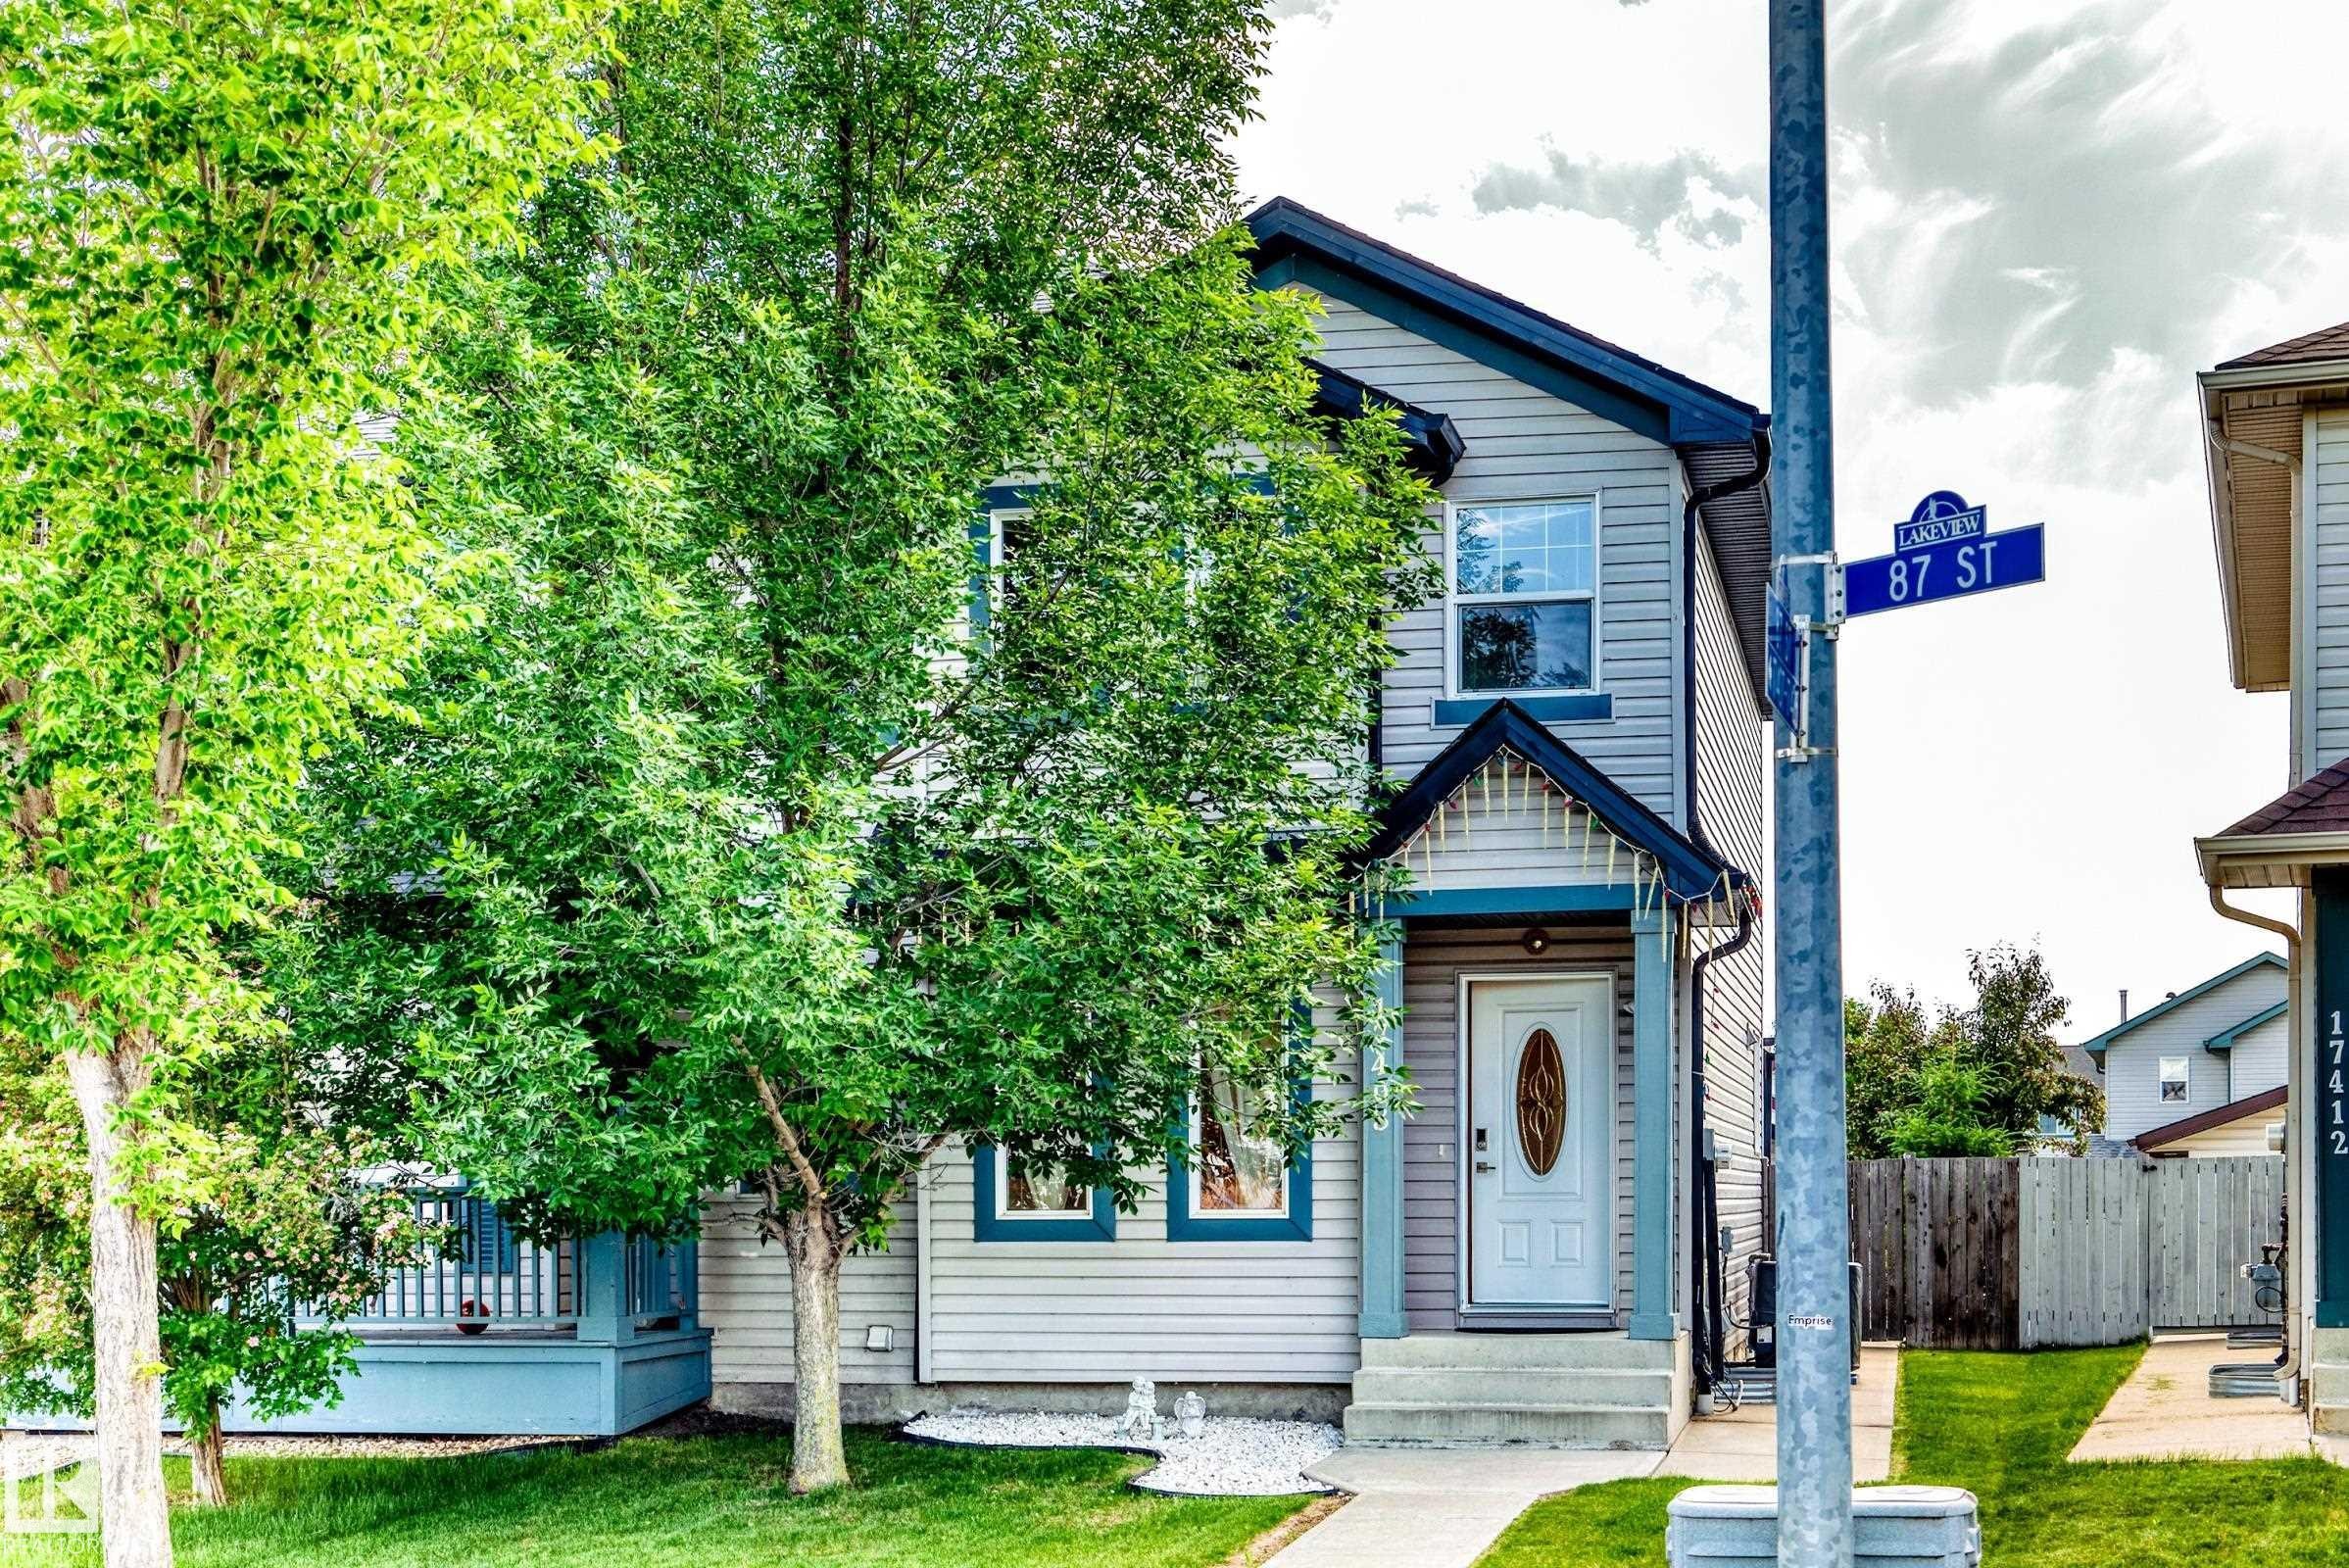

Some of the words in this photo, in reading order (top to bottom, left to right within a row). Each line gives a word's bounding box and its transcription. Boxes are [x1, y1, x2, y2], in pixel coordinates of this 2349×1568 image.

[1899, 514, 1980, 547] LAKEVIEW
[1889, 555, 1932, 602] 87
[1956, 541, 1997, 588] ST
[2328, 1010, 2349, 1154] 17412
